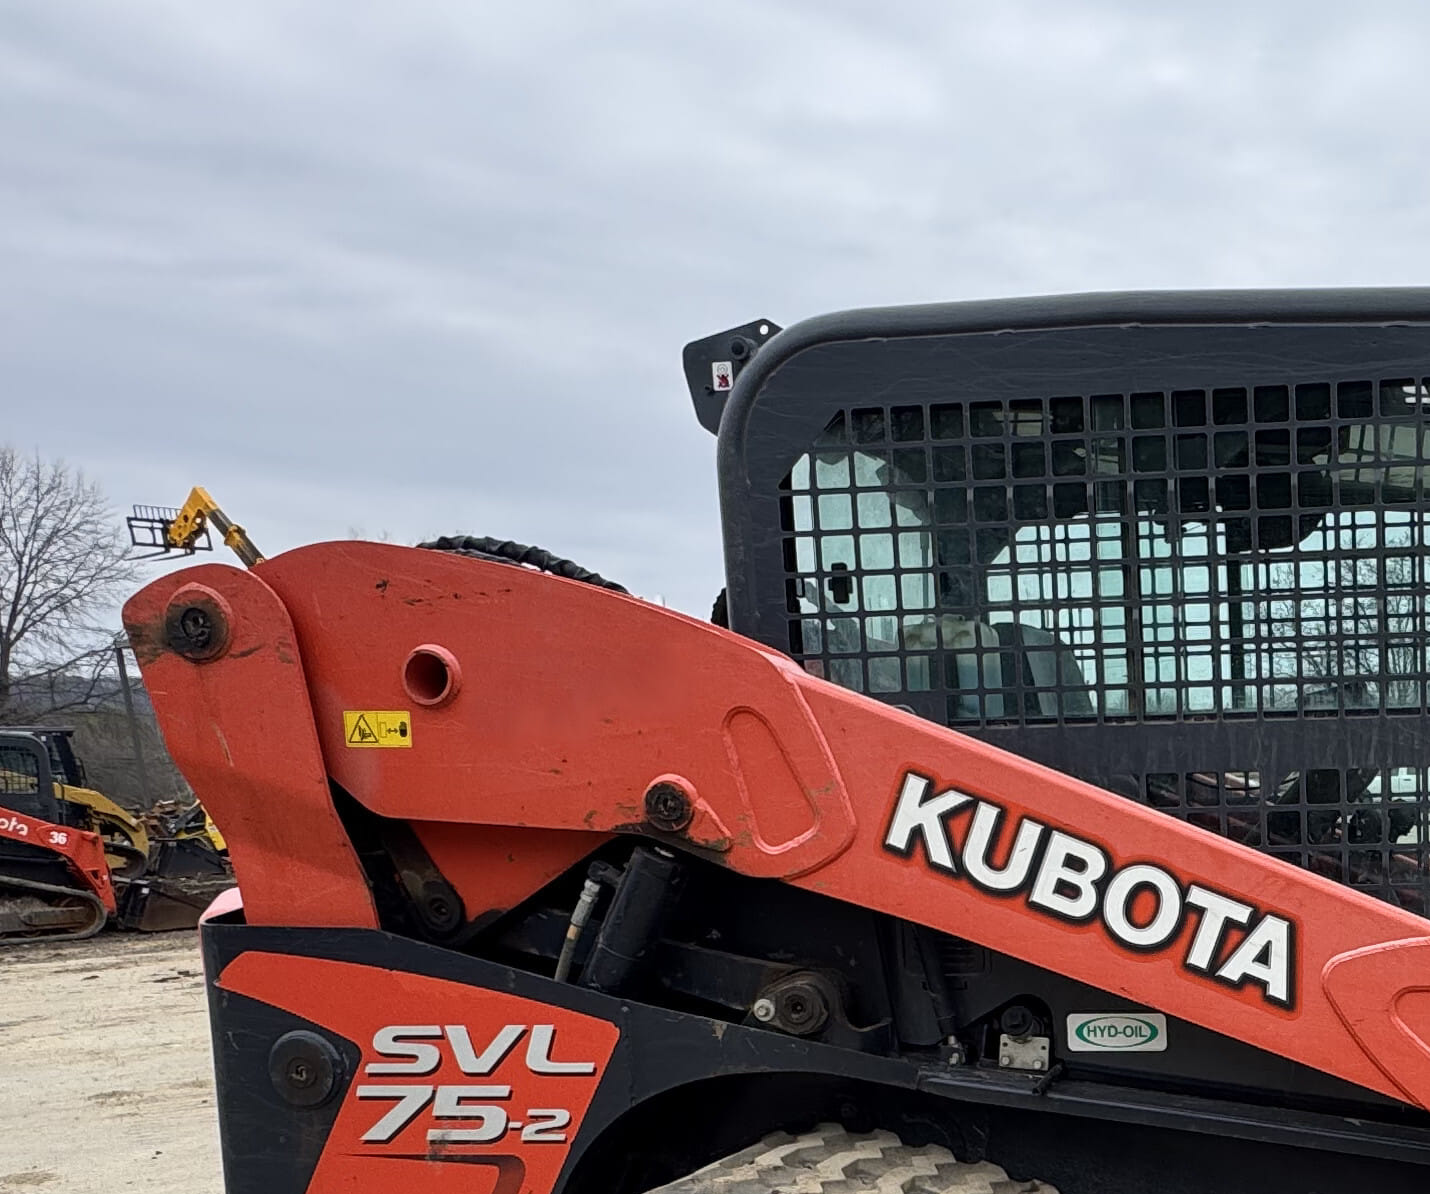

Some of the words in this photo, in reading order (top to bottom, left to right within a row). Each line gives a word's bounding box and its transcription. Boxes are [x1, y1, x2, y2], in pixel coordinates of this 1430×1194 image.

[49, 831, 68, 845] 36
[884, 771, 1292, 1003] KUBOTA
[364, 1024, 597, 1077] SVL
[1087, 1025, 1148, 1038] HYD-OIL
[356, 1085, 571, 1144] 75-2
